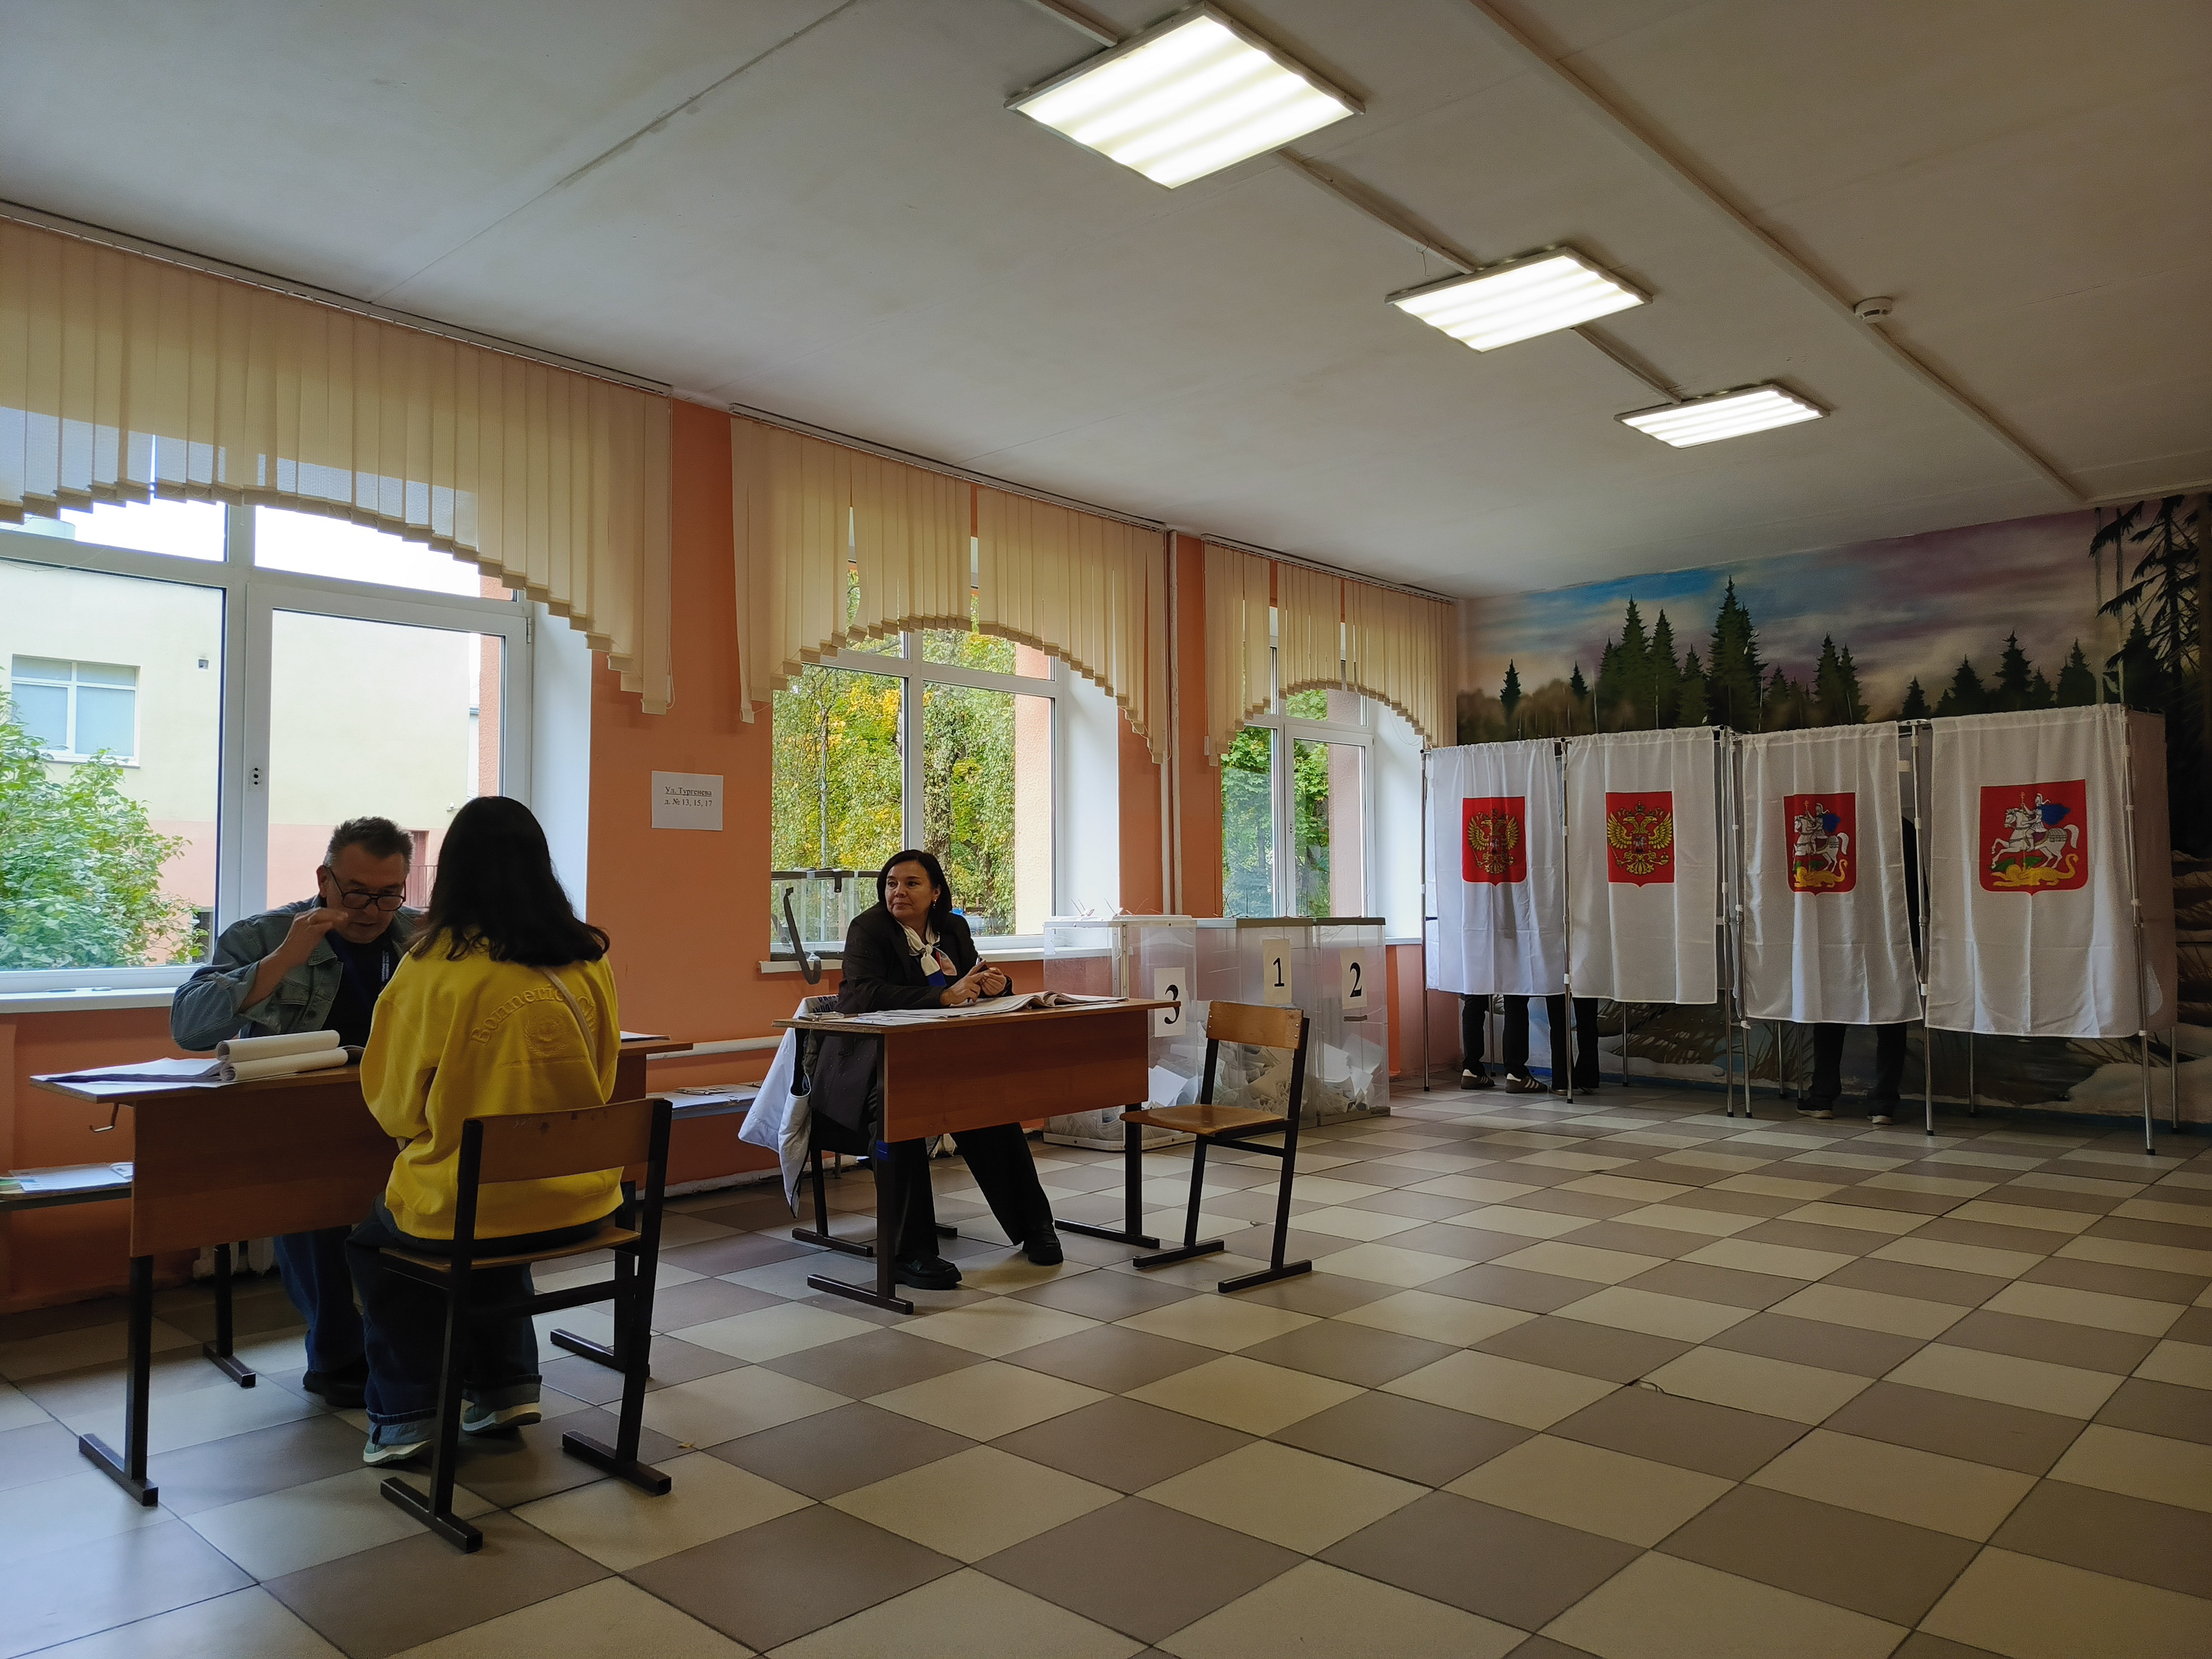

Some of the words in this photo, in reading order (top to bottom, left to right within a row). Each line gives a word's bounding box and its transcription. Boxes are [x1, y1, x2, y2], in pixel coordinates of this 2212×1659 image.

[678, 787, 712, 796] Тургенева
[1273, 957, 1285, 987] 1
[1349, 962, 1362, 998] 2
[1163, 984, 1180, 1025] 3
